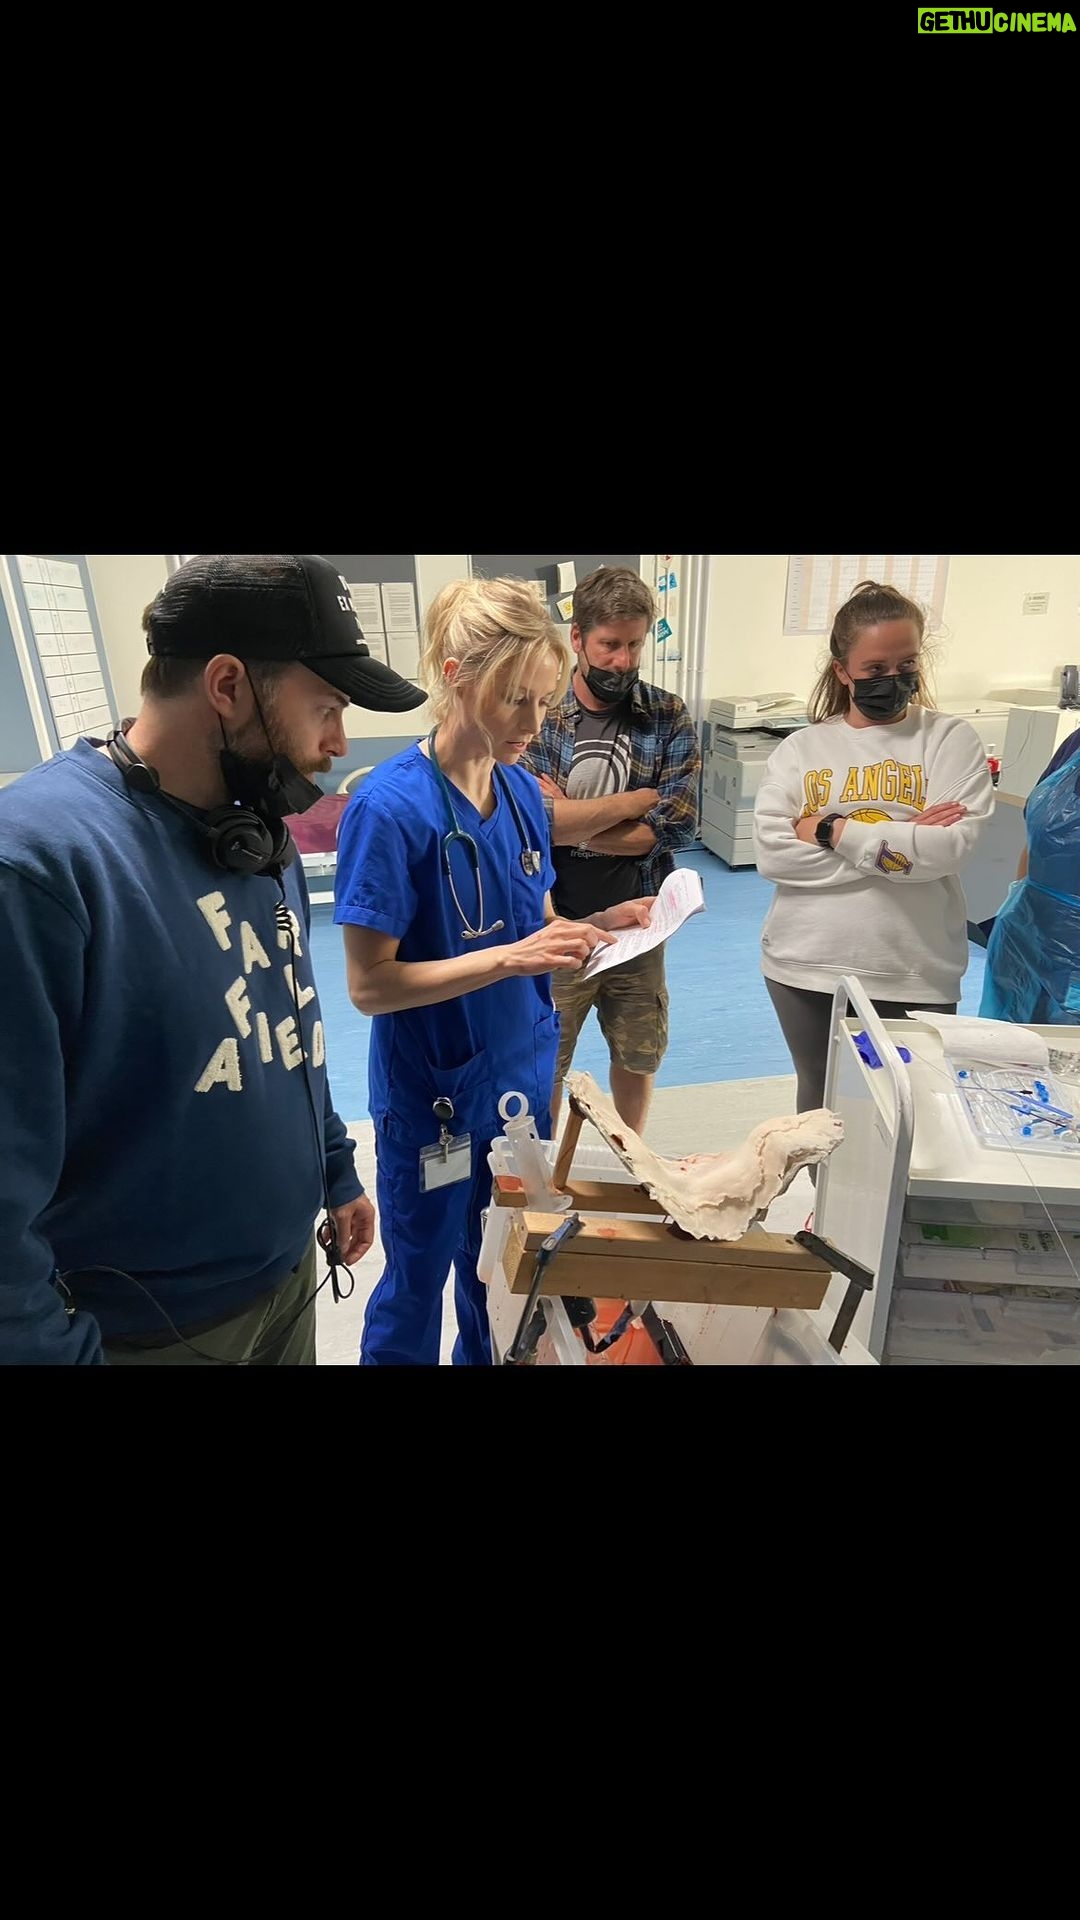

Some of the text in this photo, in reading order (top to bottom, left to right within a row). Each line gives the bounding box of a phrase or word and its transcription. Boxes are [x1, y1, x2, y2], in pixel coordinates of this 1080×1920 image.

[839, 758, 928, 813] ANGEL
[570, 850, 616, 860] frequen
[196, 891, 303, 974] FAR
